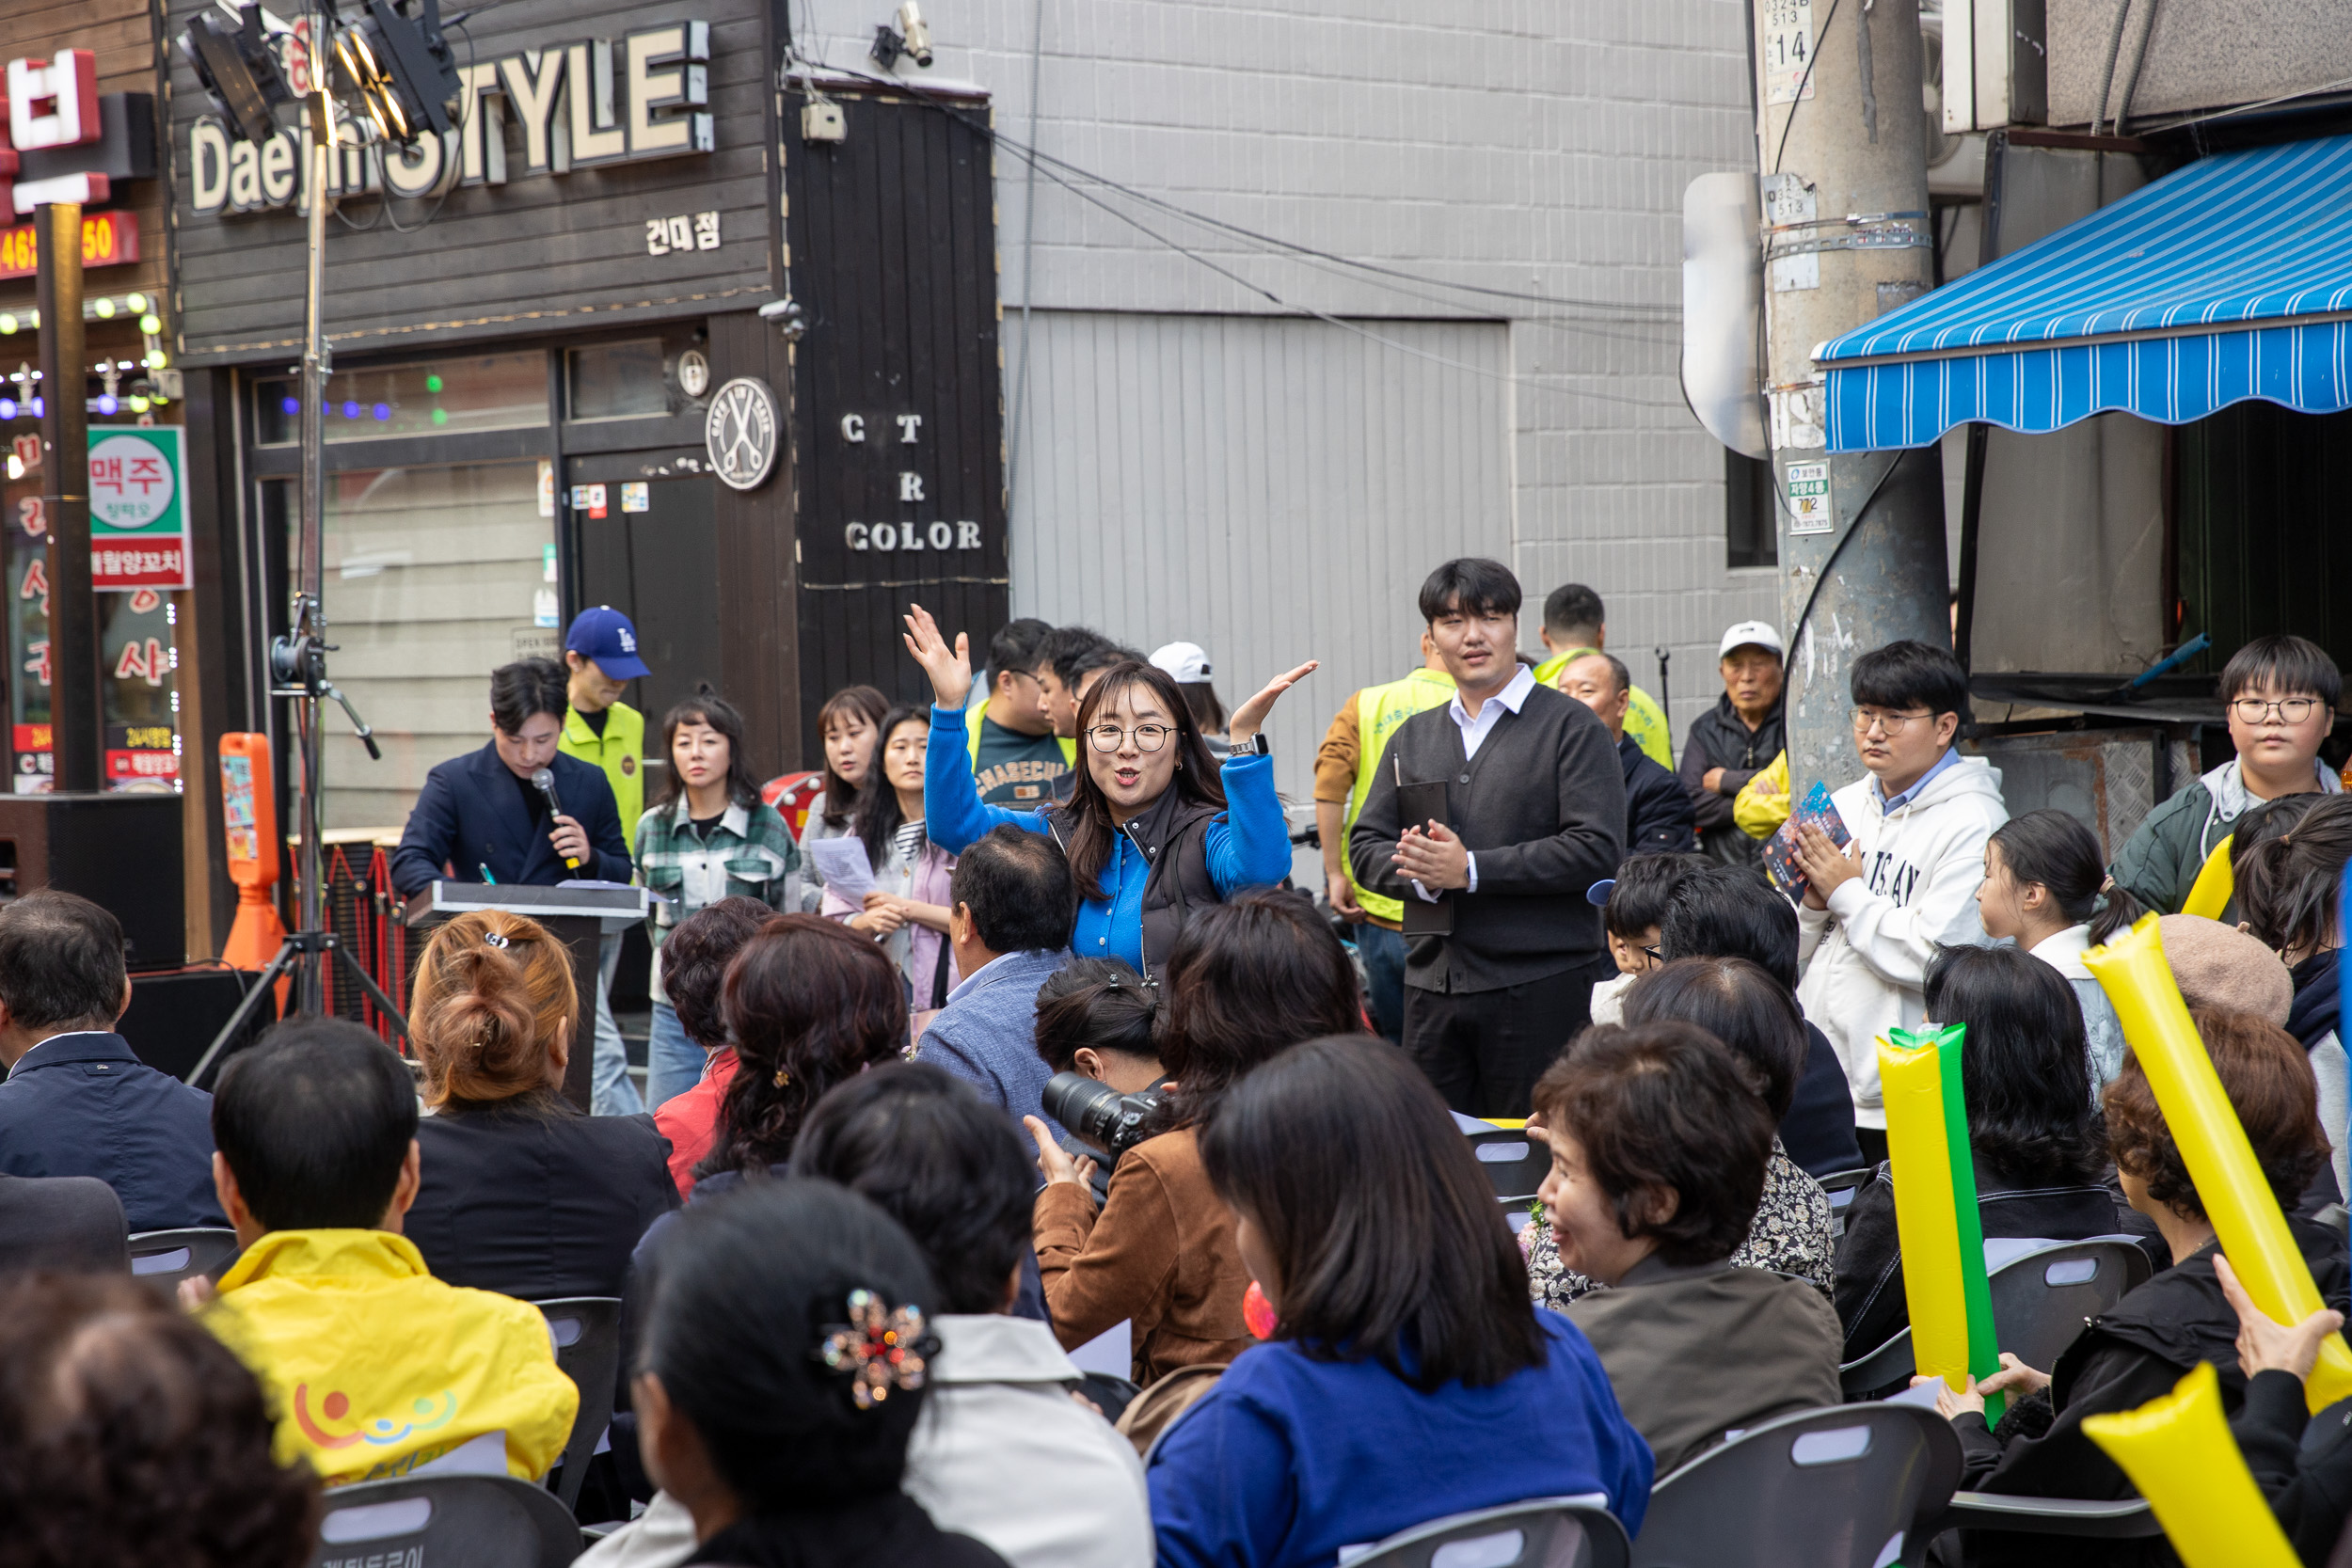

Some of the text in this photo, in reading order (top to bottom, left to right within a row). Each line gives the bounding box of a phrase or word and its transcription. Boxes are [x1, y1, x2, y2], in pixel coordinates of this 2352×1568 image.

[1772, 10, 1797, 26] 513
[1777, 31, 1805, 65] 14
[1778, 201, 1804, 215] 513
[897, 414, 922, 443] T
[89, 456, 163, 495] 맥주
[898, 471, 926, 502] R
[1790, 481, 1825, 496] 자양4동
